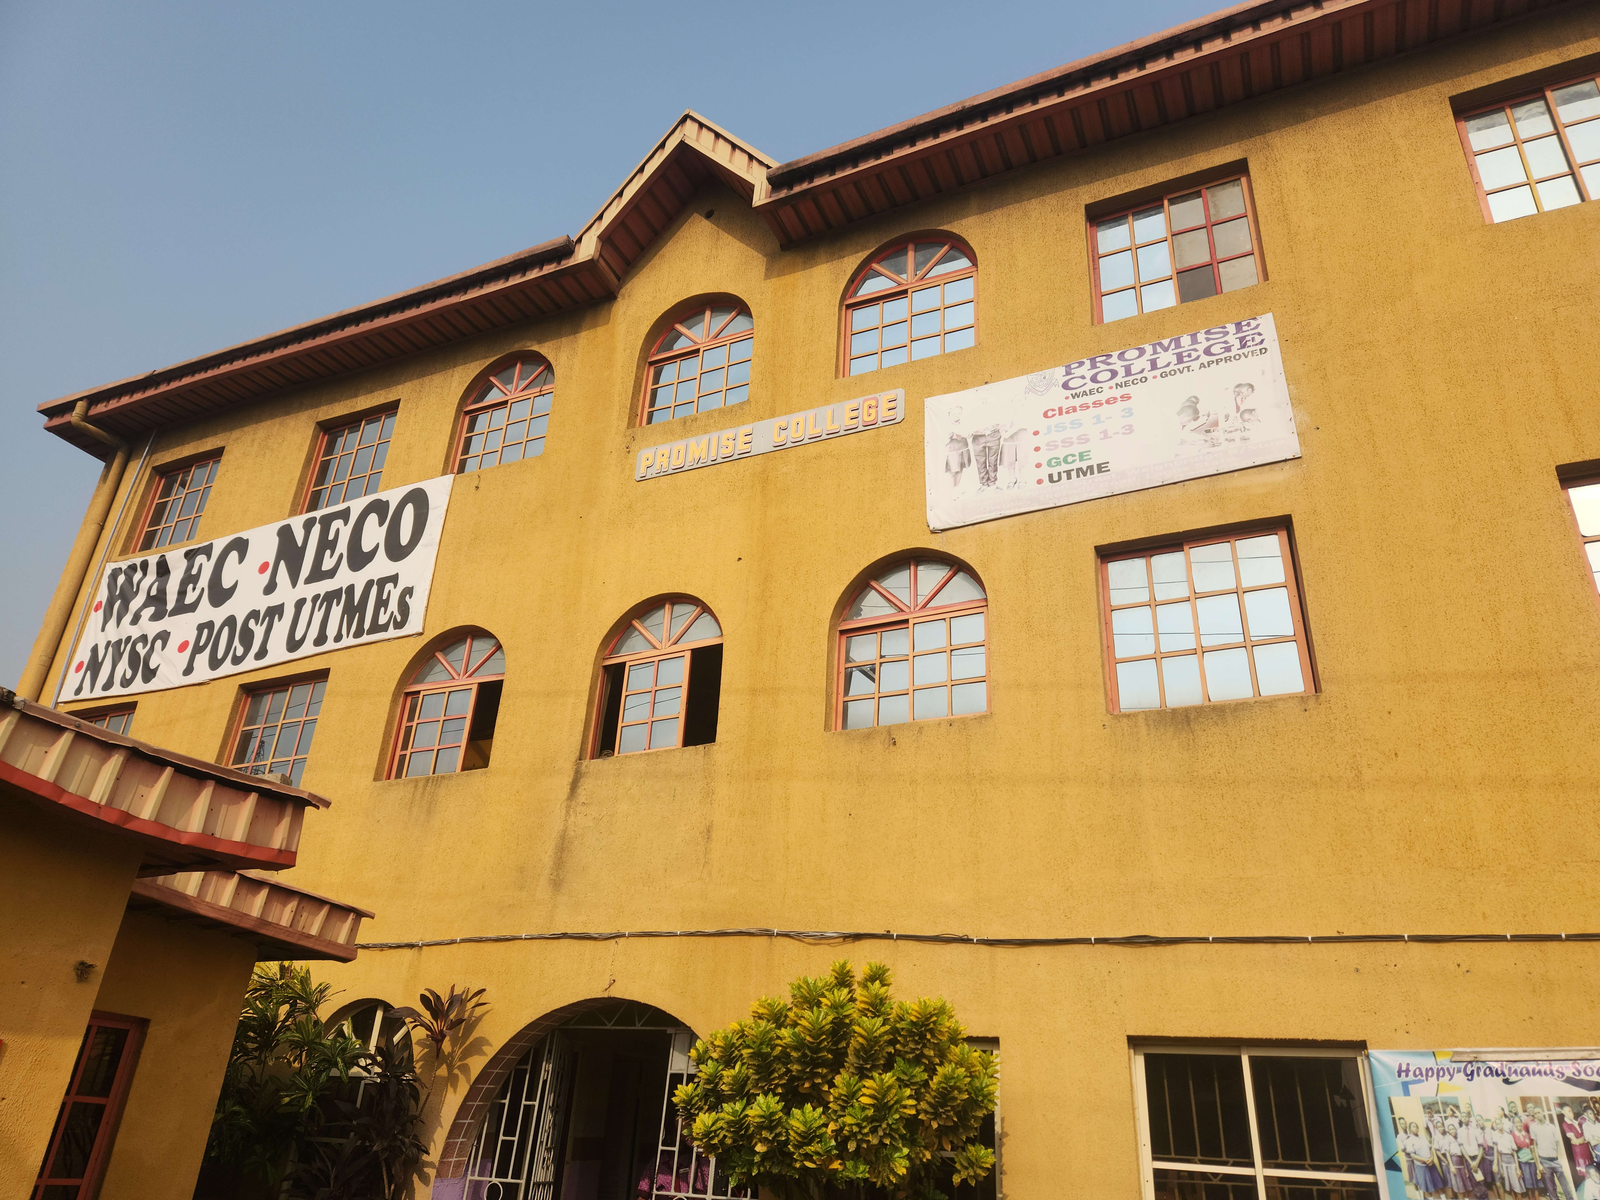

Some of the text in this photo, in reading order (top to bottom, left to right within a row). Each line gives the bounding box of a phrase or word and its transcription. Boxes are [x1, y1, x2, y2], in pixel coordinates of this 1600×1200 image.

[1061, 331, 1265, 391] COLLEGE
[1062, 316, 1263, 377] PROMISE
[1070, 347, 1268, 400] WAEC NECO GOVT. APPROVED
[1042, 393, 1132, 419] Classes
[1043, 416, 1083, 436] JSS
[639, 393, 898, 478] PROMISE COLLEGE
[1045, 424, 1135, 451] SSS 1-3
[1046, 450, 1092, 468] GCE
[1048, 461, 1111, 484] UTME
[100, 487, 430, 633] WAEC NECO
[74, 629, 171, 697] NYSC
[182, 603, 285, 677] POST
[1396, 1062, 1456, 1082] Happy
